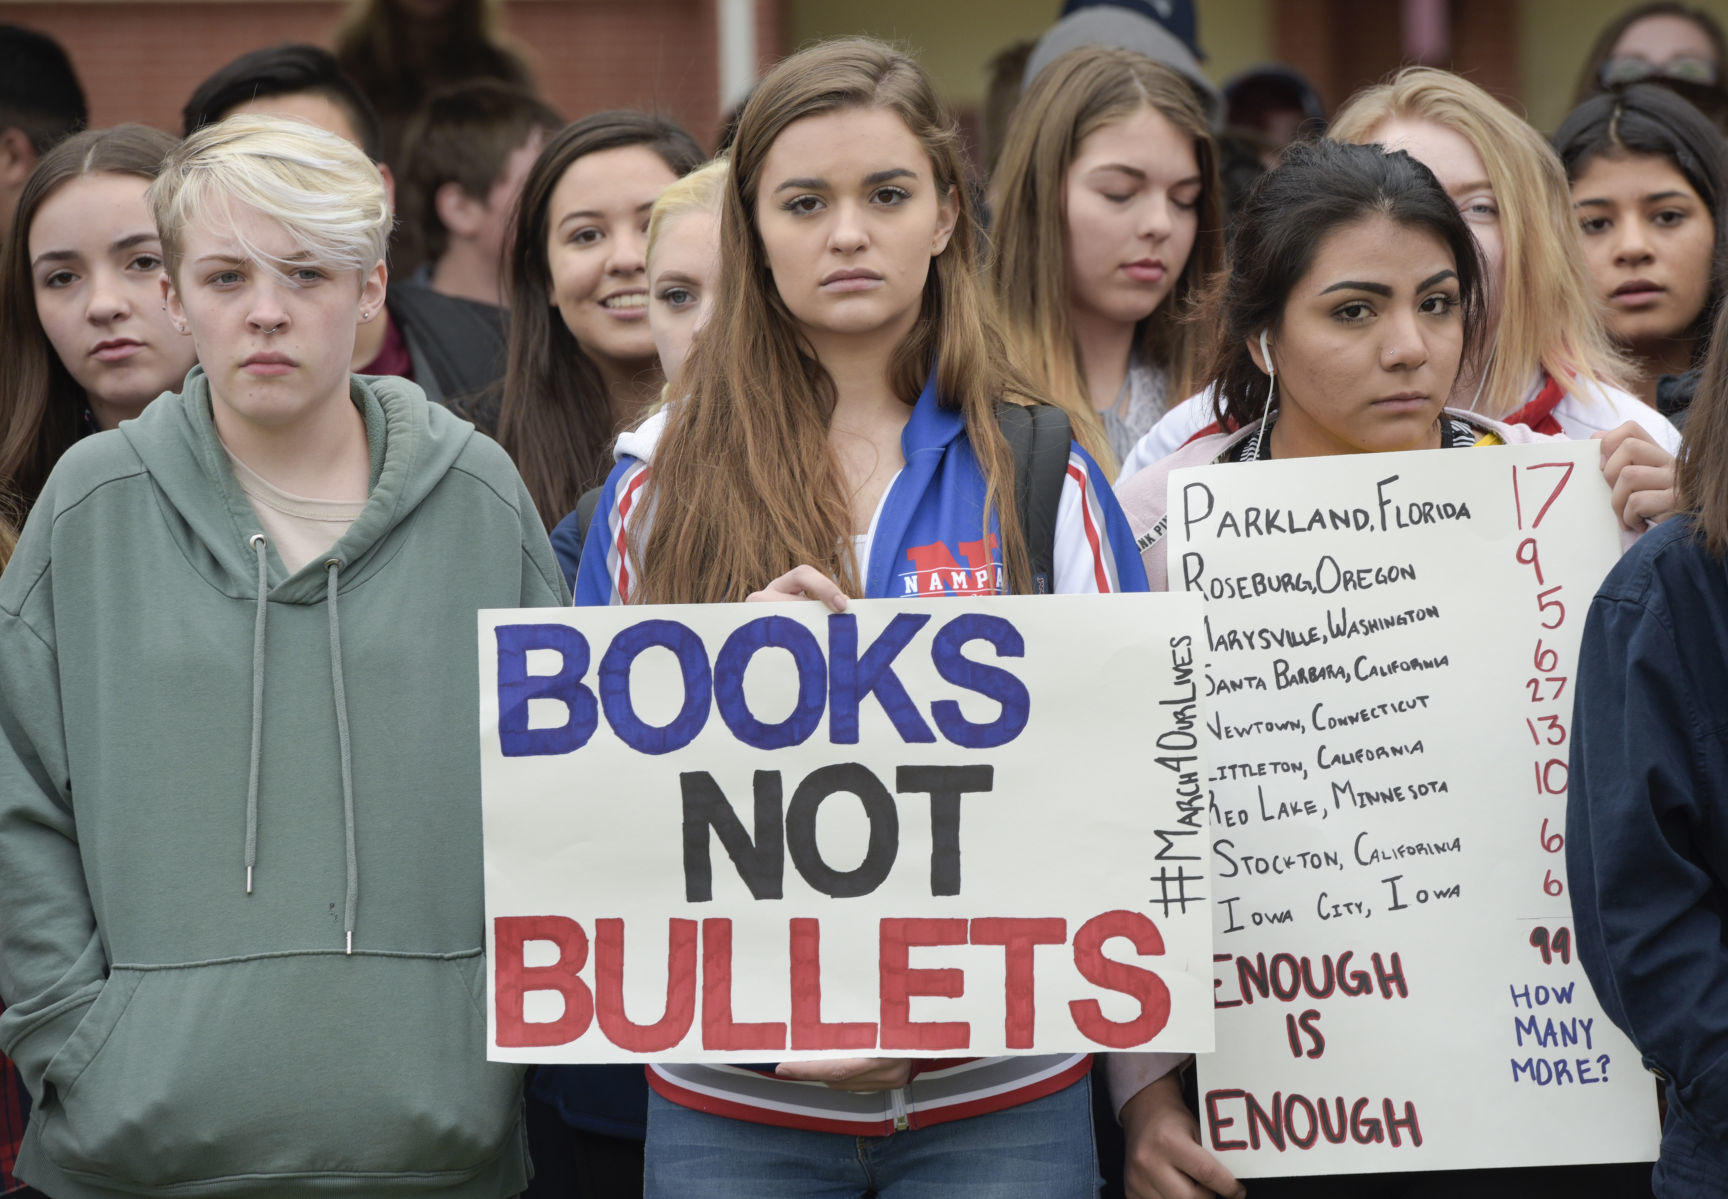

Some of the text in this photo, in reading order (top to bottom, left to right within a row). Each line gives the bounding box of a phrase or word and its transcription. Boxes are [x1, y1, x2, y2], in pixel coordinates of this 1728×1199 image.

[1376, 474, 1471, 532] FLORIDA
[1512, 461, 1575, 530] 17
[904, 567, 1004, 594] NAMPA
[1315, 555, 1417, 594] OREGON
[1515, 537, 1545, 586] 9
[1326, 605, 1440, 639] WASHINGTON
[1536, 579, 1566, 630] 5
[1272, 658, 1352, 691] BARBARA,
[1533, 638, 1559, 673] 6
[494, 612, 1031, 757] BOOKS
[1525, 676, 1568, 703] 27
[1311, 695, 1430, 731] CONNECTICUT
[1526, 714, 1567, 746] 13
[1317, 739, 1424, 770] CALIFORNIA
[1534, 758, 1568, 795] 10
[1257, 785, 1328, 822] LAKE,
[1331, 779, 1449, 810] MINNESOTA
[678, 761, 995, 903] NOT
[1540, 817, 1565, 854] 6
[1212, 838, 1344, 878] STOCKTON,
[1543, 868, 1564, 897] 6
[1217, 874, 1461, 934] IOWA CITY, IOWA
[1528, 925, 1571, 966] 99
[494, 909, 1172, 1053] BULLETS
[1214, 950, 1409, 1008] ENOUGH
[1509, 981, 1576, 1010] HOW
[1285, 1008, 1326, 1060] IS
[1514, 1014, 1594, 1051] MANY
[1510, 1053, 1611, 1086] MORE?
[1205, 1089, 1423, 1152] ENOUGH
